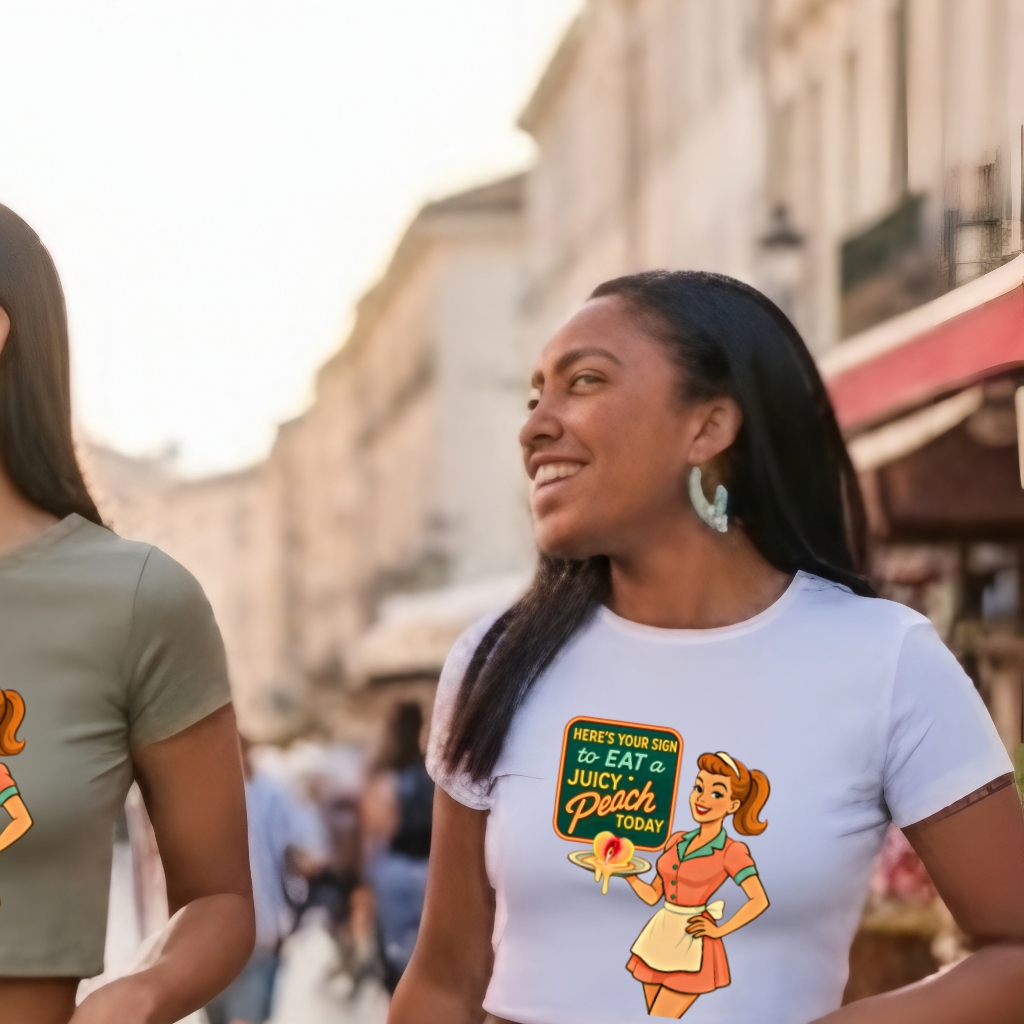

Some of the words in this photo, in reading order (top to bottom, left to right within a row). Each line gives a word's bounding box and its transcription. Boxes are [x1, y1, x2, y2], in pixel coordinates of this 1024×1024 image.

[573, 728, 615, 745] HERE'S
[618, 734, 649, 749] YOUR
[652, 738, 678, 753] SIGN
[578, 747, 600, 764] to
[605, 749, 648, 771] EAT
[649, 761, 665, 773] a
[567, 769, 622, 790] JUICY
[565, 781, 656, 834] Peach
[616, 814, 664, 833] TODAY
